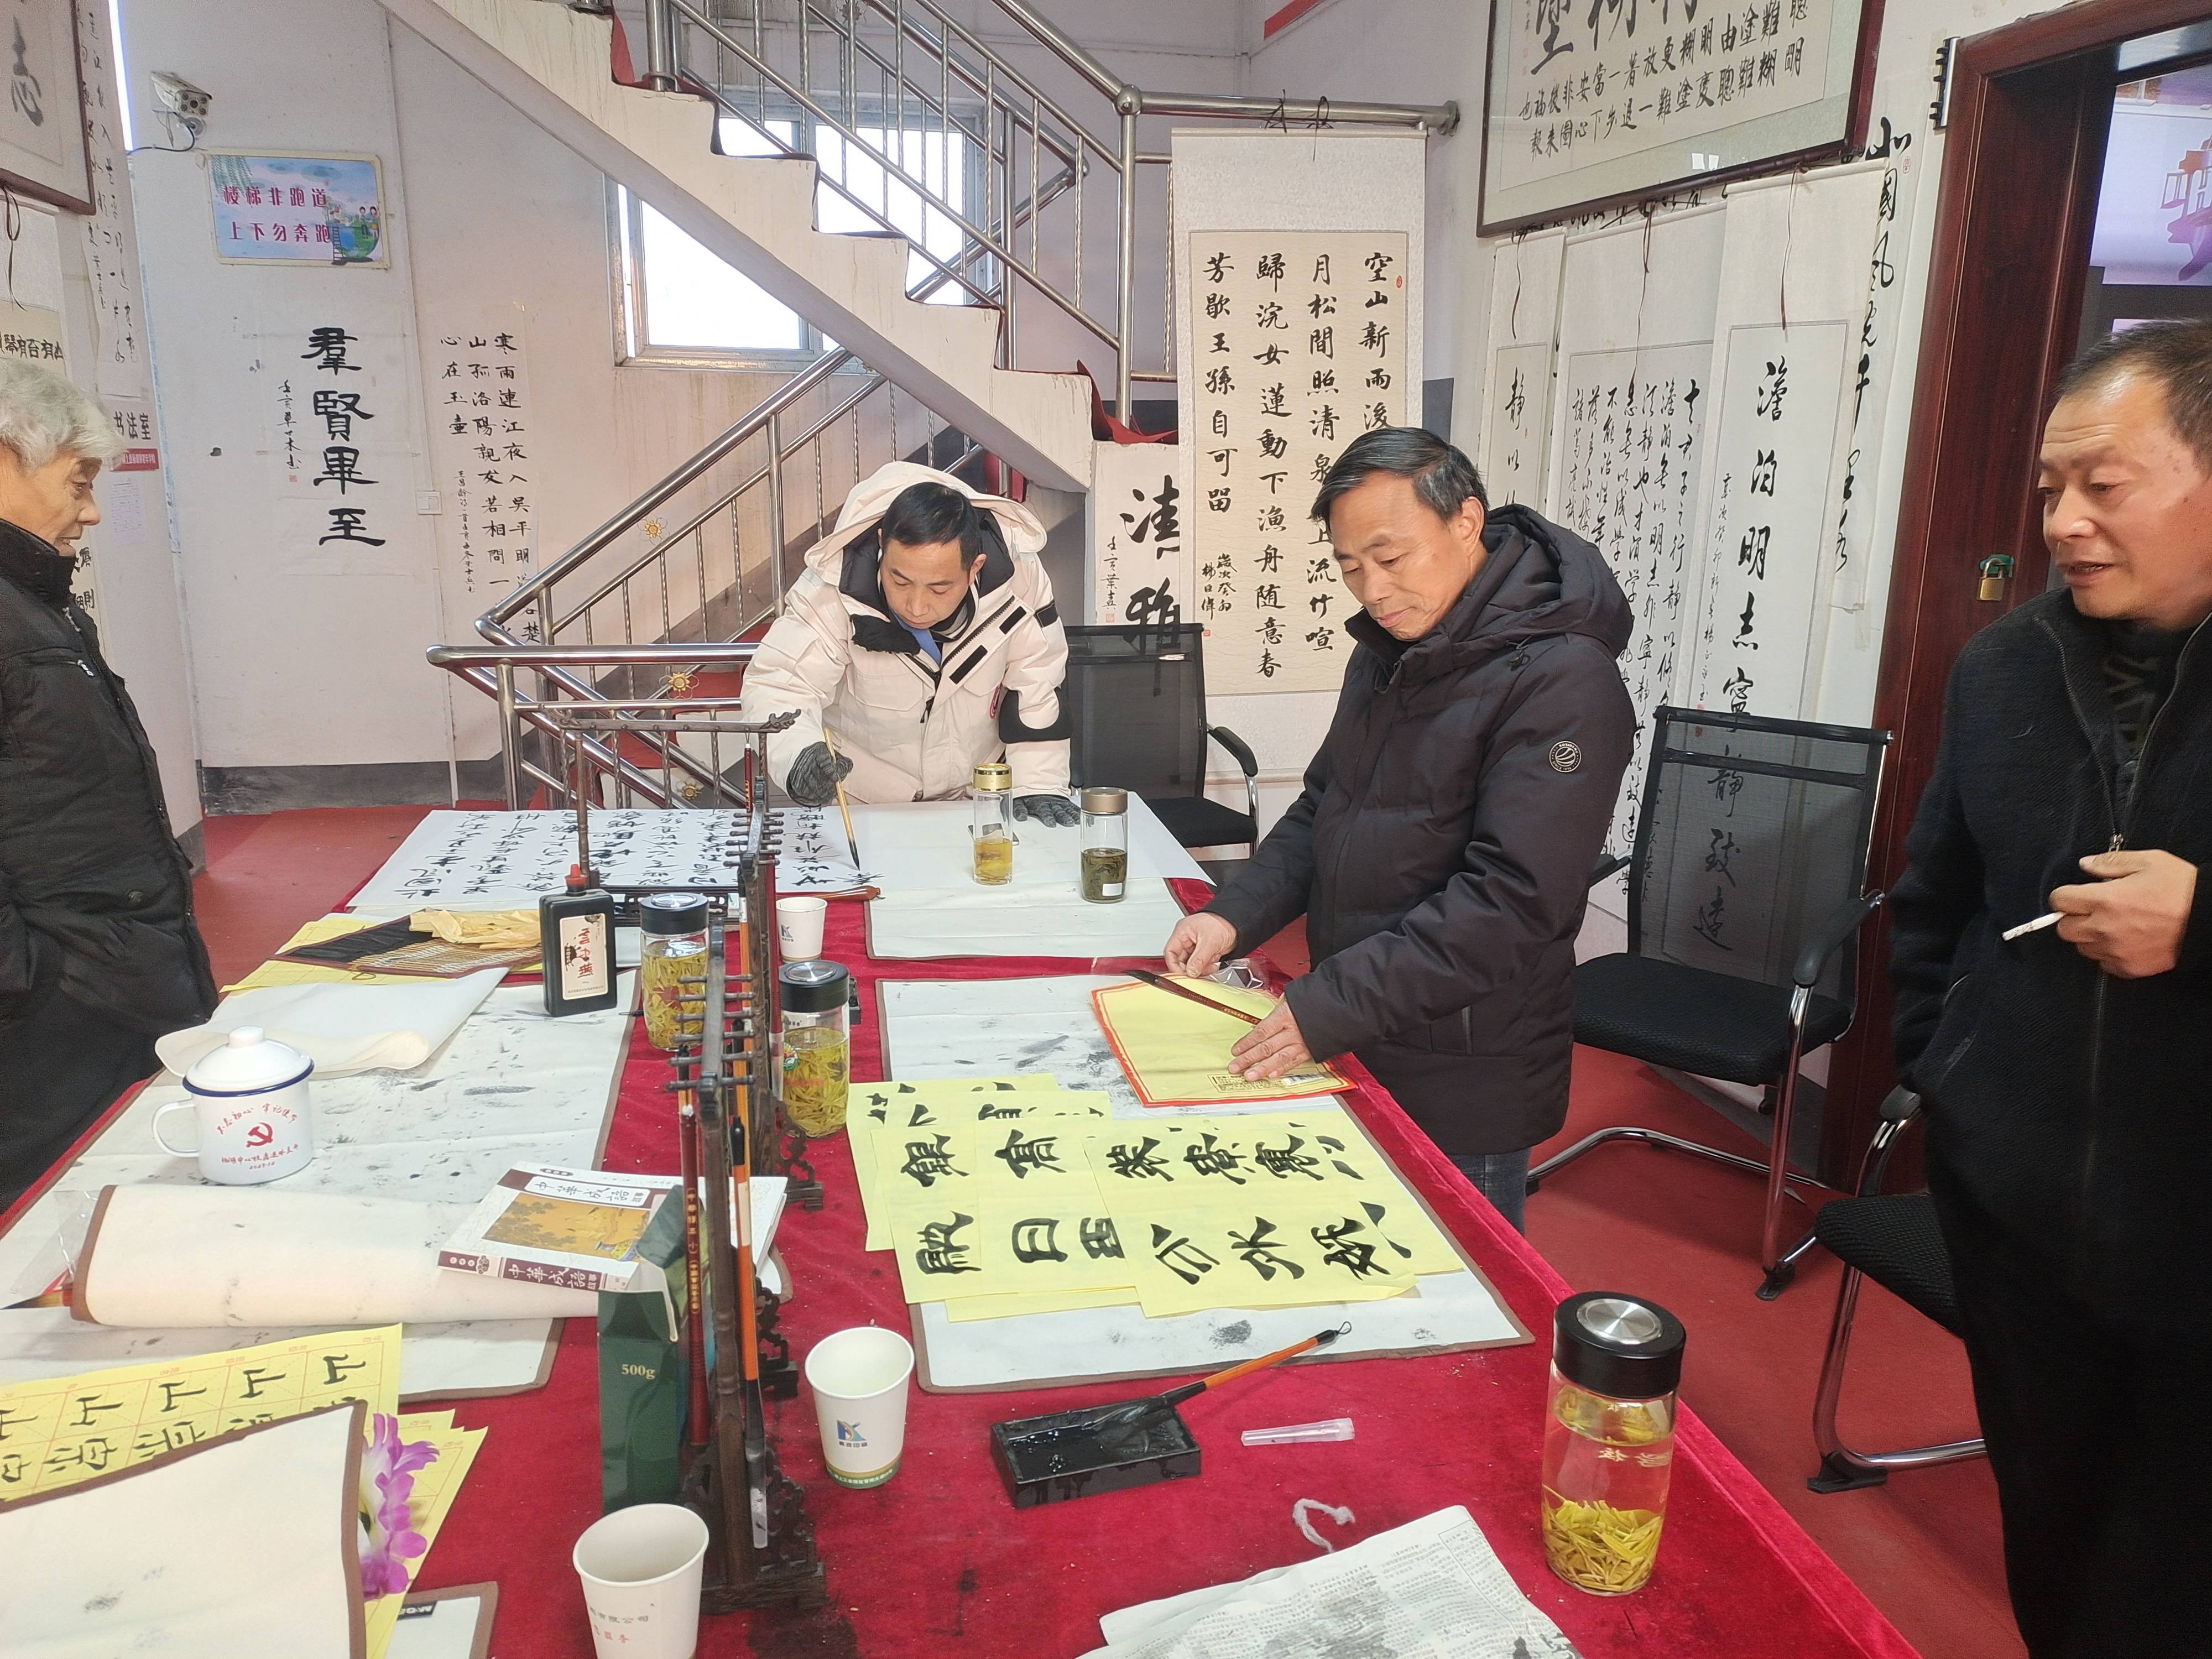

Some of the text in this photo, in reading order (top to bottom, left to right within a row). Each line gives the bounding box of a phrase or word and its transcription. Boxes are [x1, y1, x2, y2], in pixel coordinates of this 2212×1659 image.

[222, 185, 327, 209] 楼梯非跑道
[229, 222, 332, 246] 上下勿奔跑
[113, 411, 152, 440] 书法室
[621, 1364, 655, 1380] 500g
